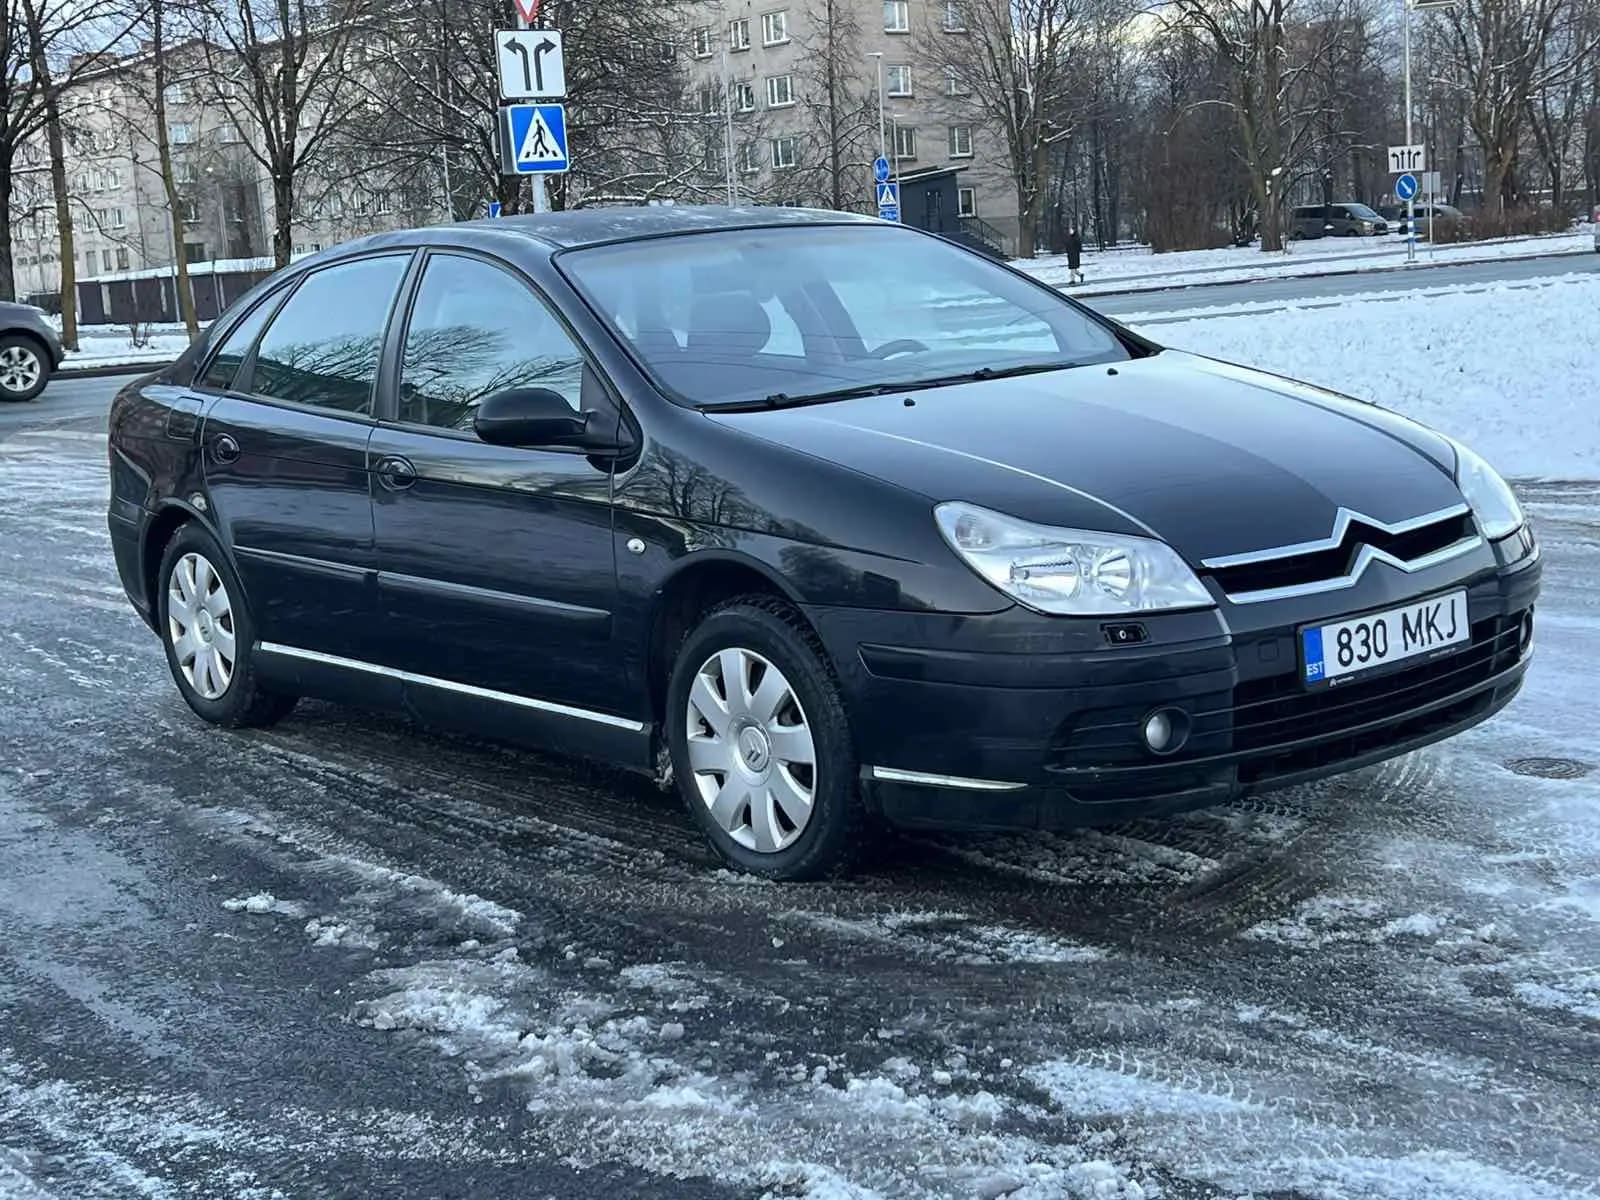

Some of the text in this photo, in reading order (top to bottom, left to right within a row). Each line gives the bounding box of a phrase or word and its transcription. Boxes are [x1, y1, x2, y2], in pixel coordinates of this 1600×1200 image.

[1336, 599, 1456, 667] 830 MKJ
[1306, 661, 1324, 676] EST
